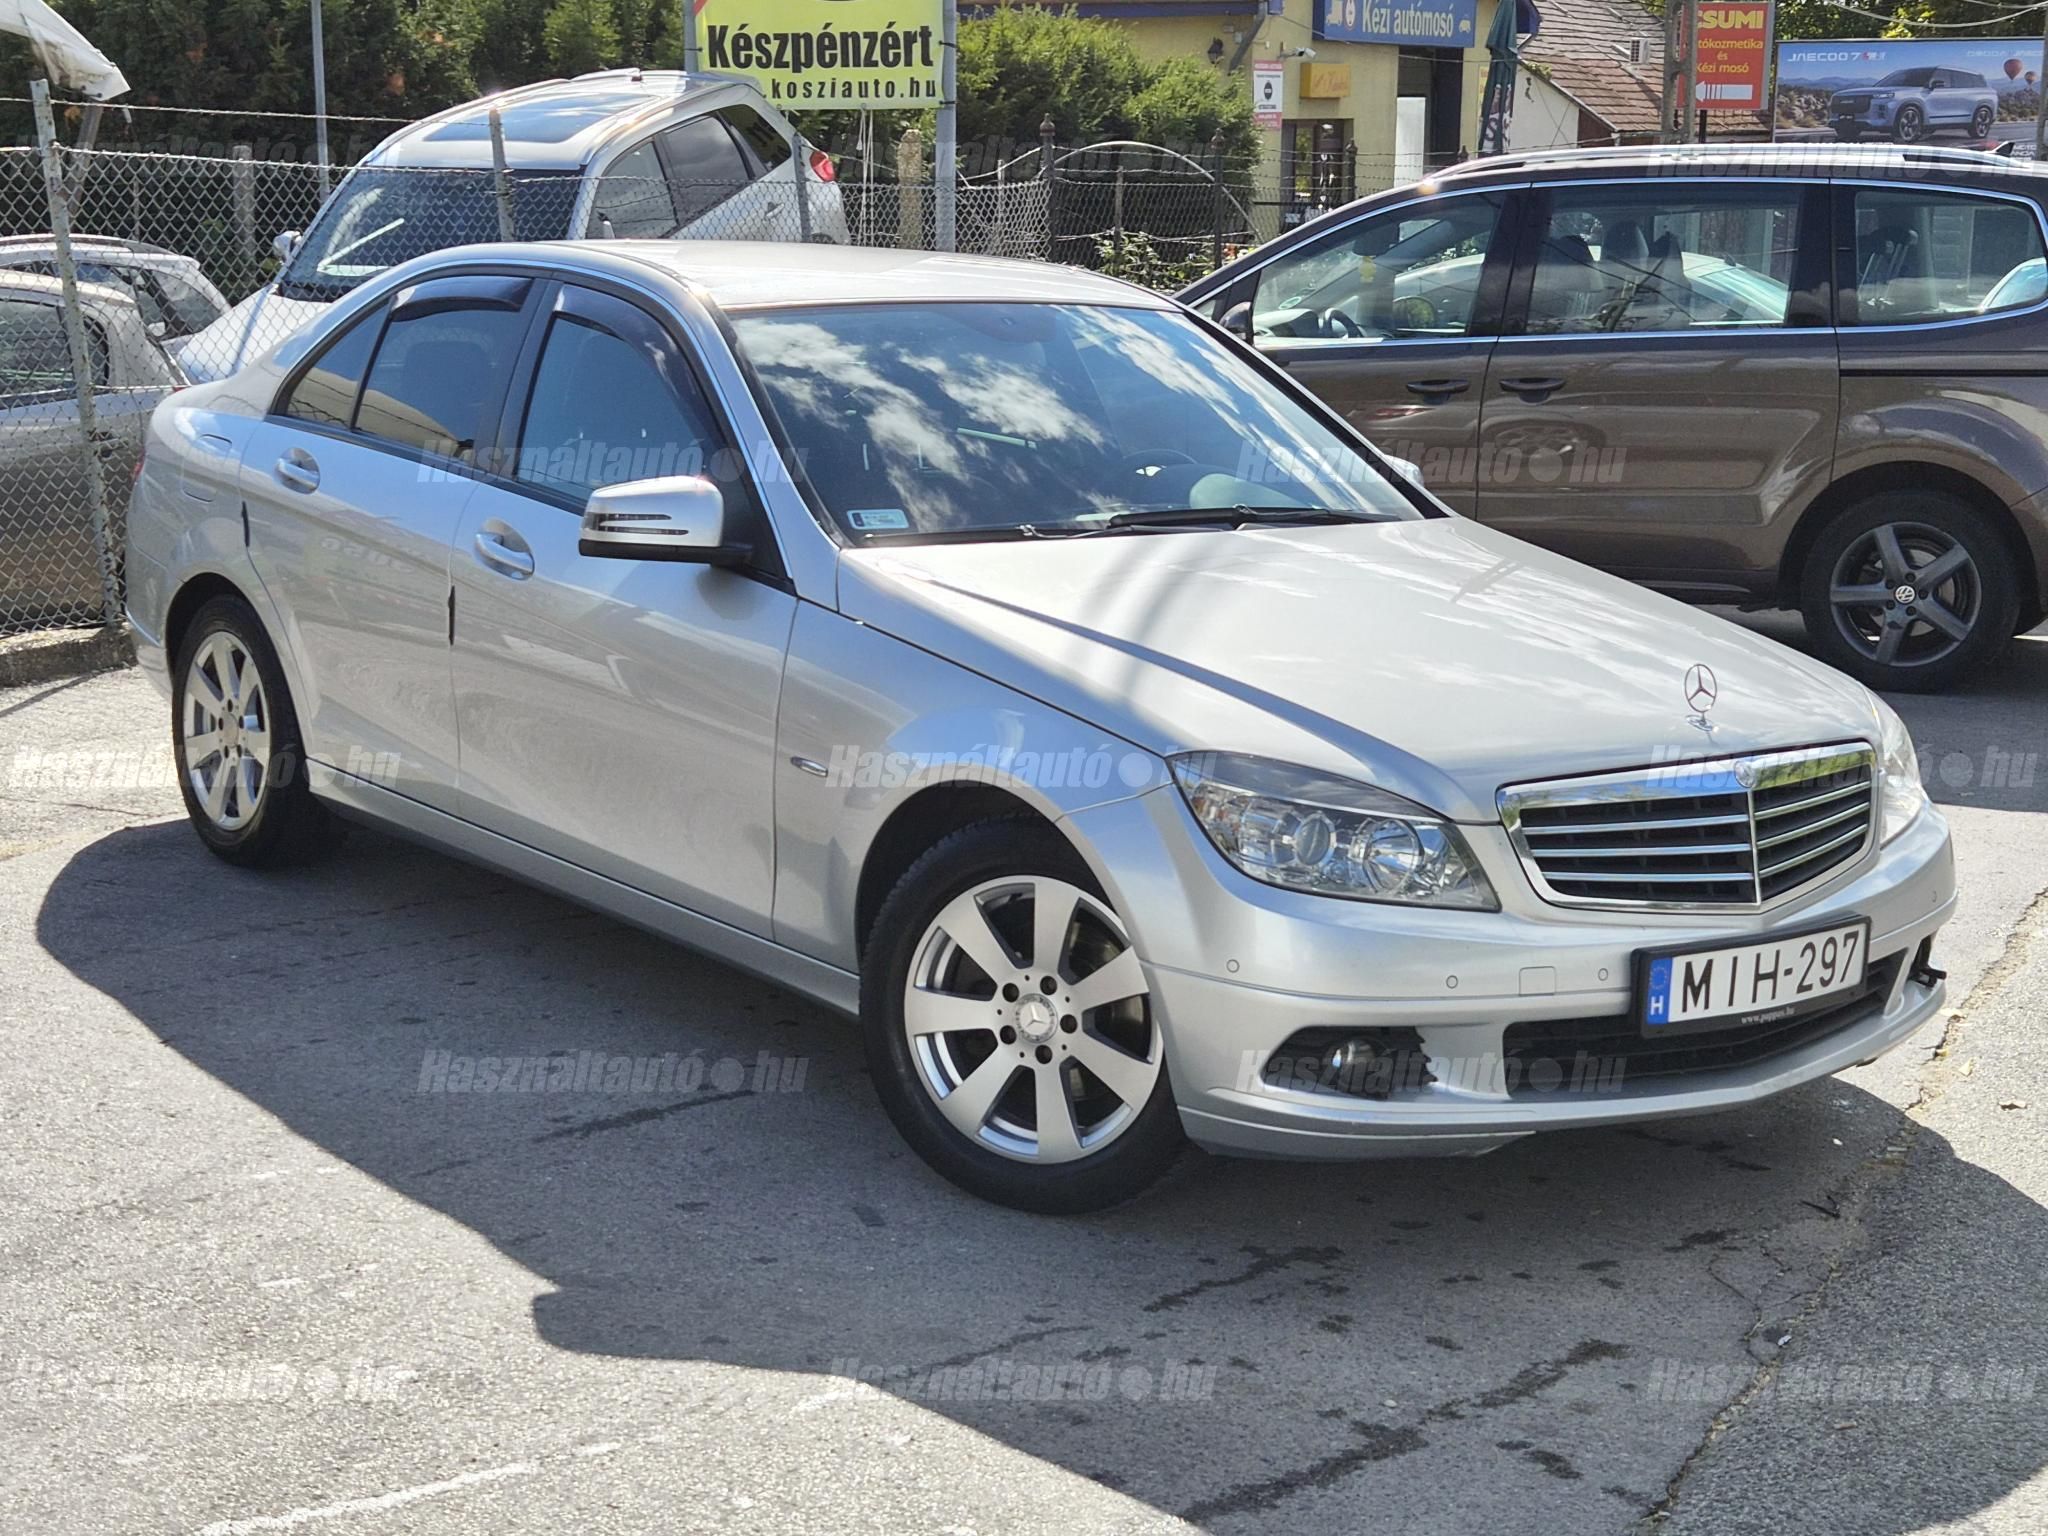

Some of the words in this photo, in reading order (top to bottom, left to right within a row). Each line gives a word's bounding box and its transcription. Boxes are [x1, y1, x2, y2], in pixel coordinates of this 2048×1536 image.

[1362, 0, 1391, 33] Kézi
[1394, 1, 1454, 38] autómosó
[707, 21, 934, 74] Készpénzért
[1698, 38, 1763, 49] tókozmetika
[1716, 50, 1728, 61] és
[1719, 62, 1749, 73] mosó
[763, 77, 937, 99] .kosziauto.hu
[1650, 995, 1663, 1015] H
[1682, 930, 1860, 1013] MIH-297
